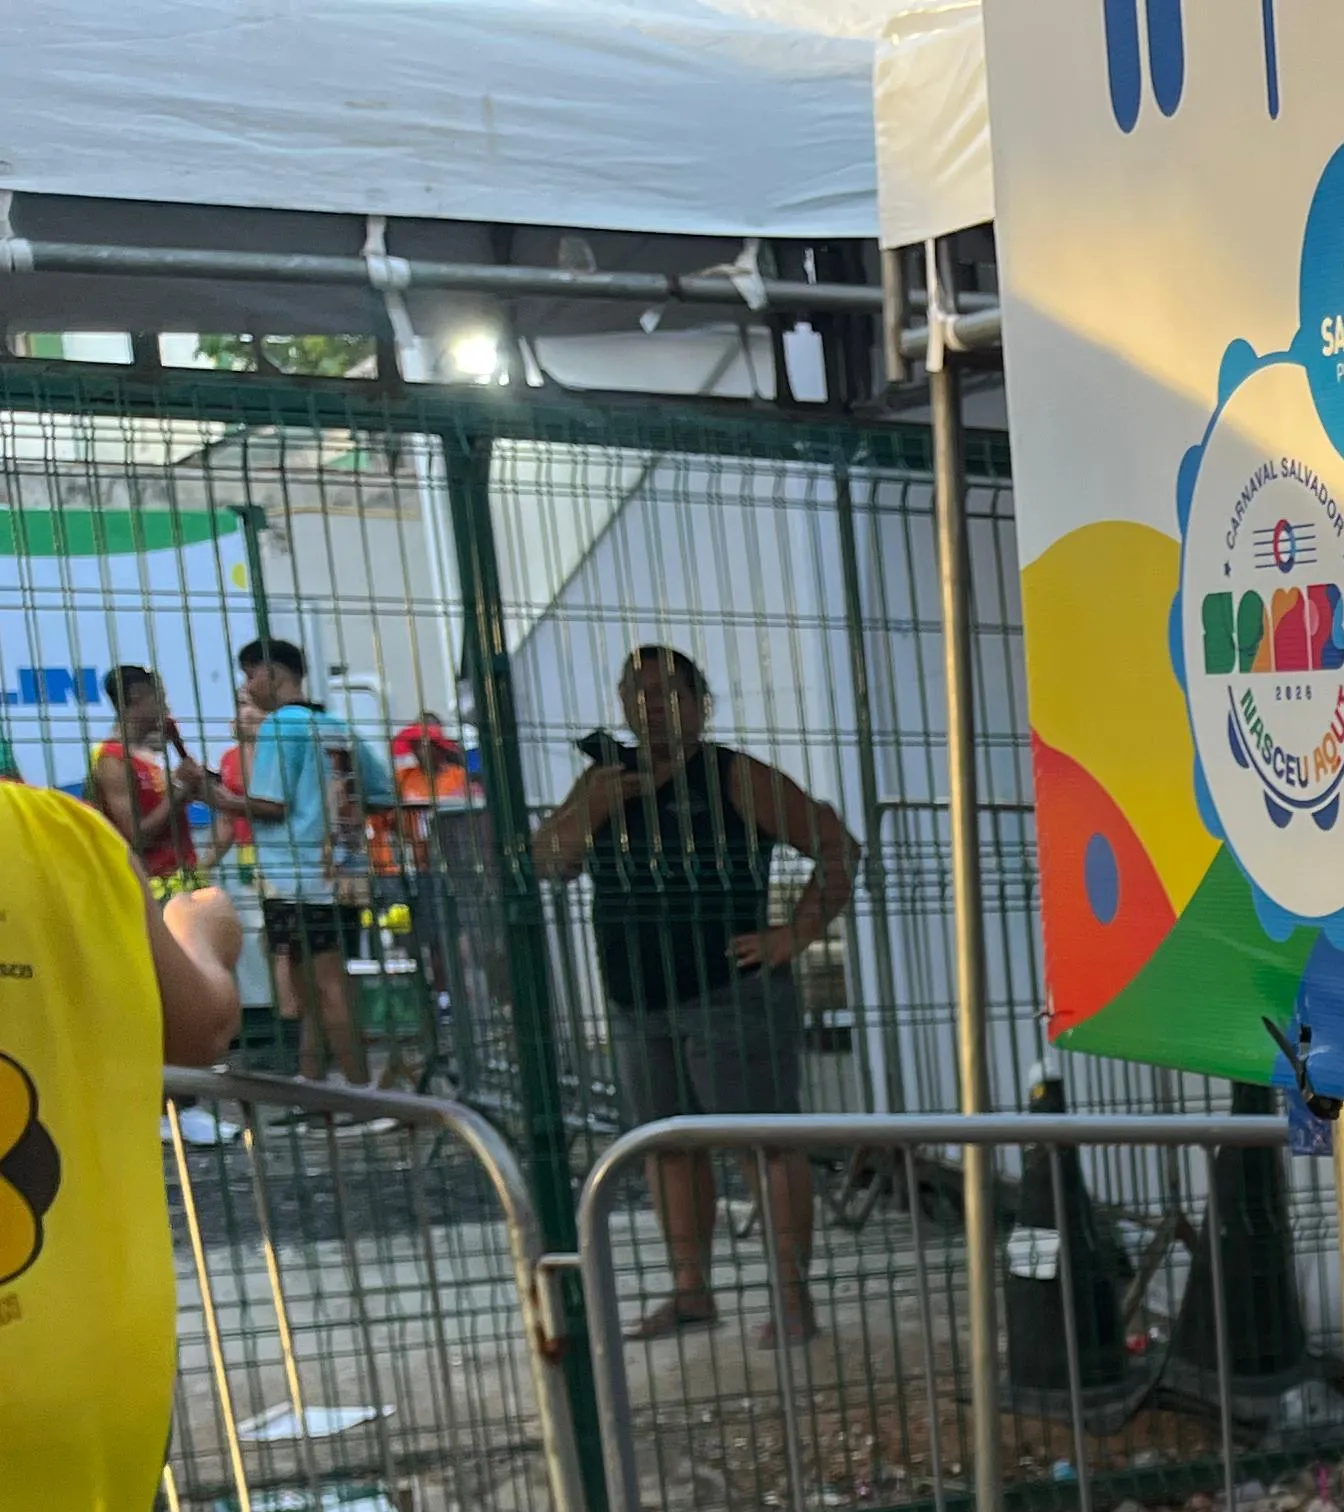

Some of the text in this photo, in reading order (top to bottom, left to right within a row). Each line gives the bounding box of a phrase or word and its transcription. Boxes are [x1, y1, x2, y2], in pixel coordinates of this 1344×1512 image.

[1225, 457, 1344, 551] CARNAVAL SALVADOR
[1240, 687, 1309, 789] NASCEU
